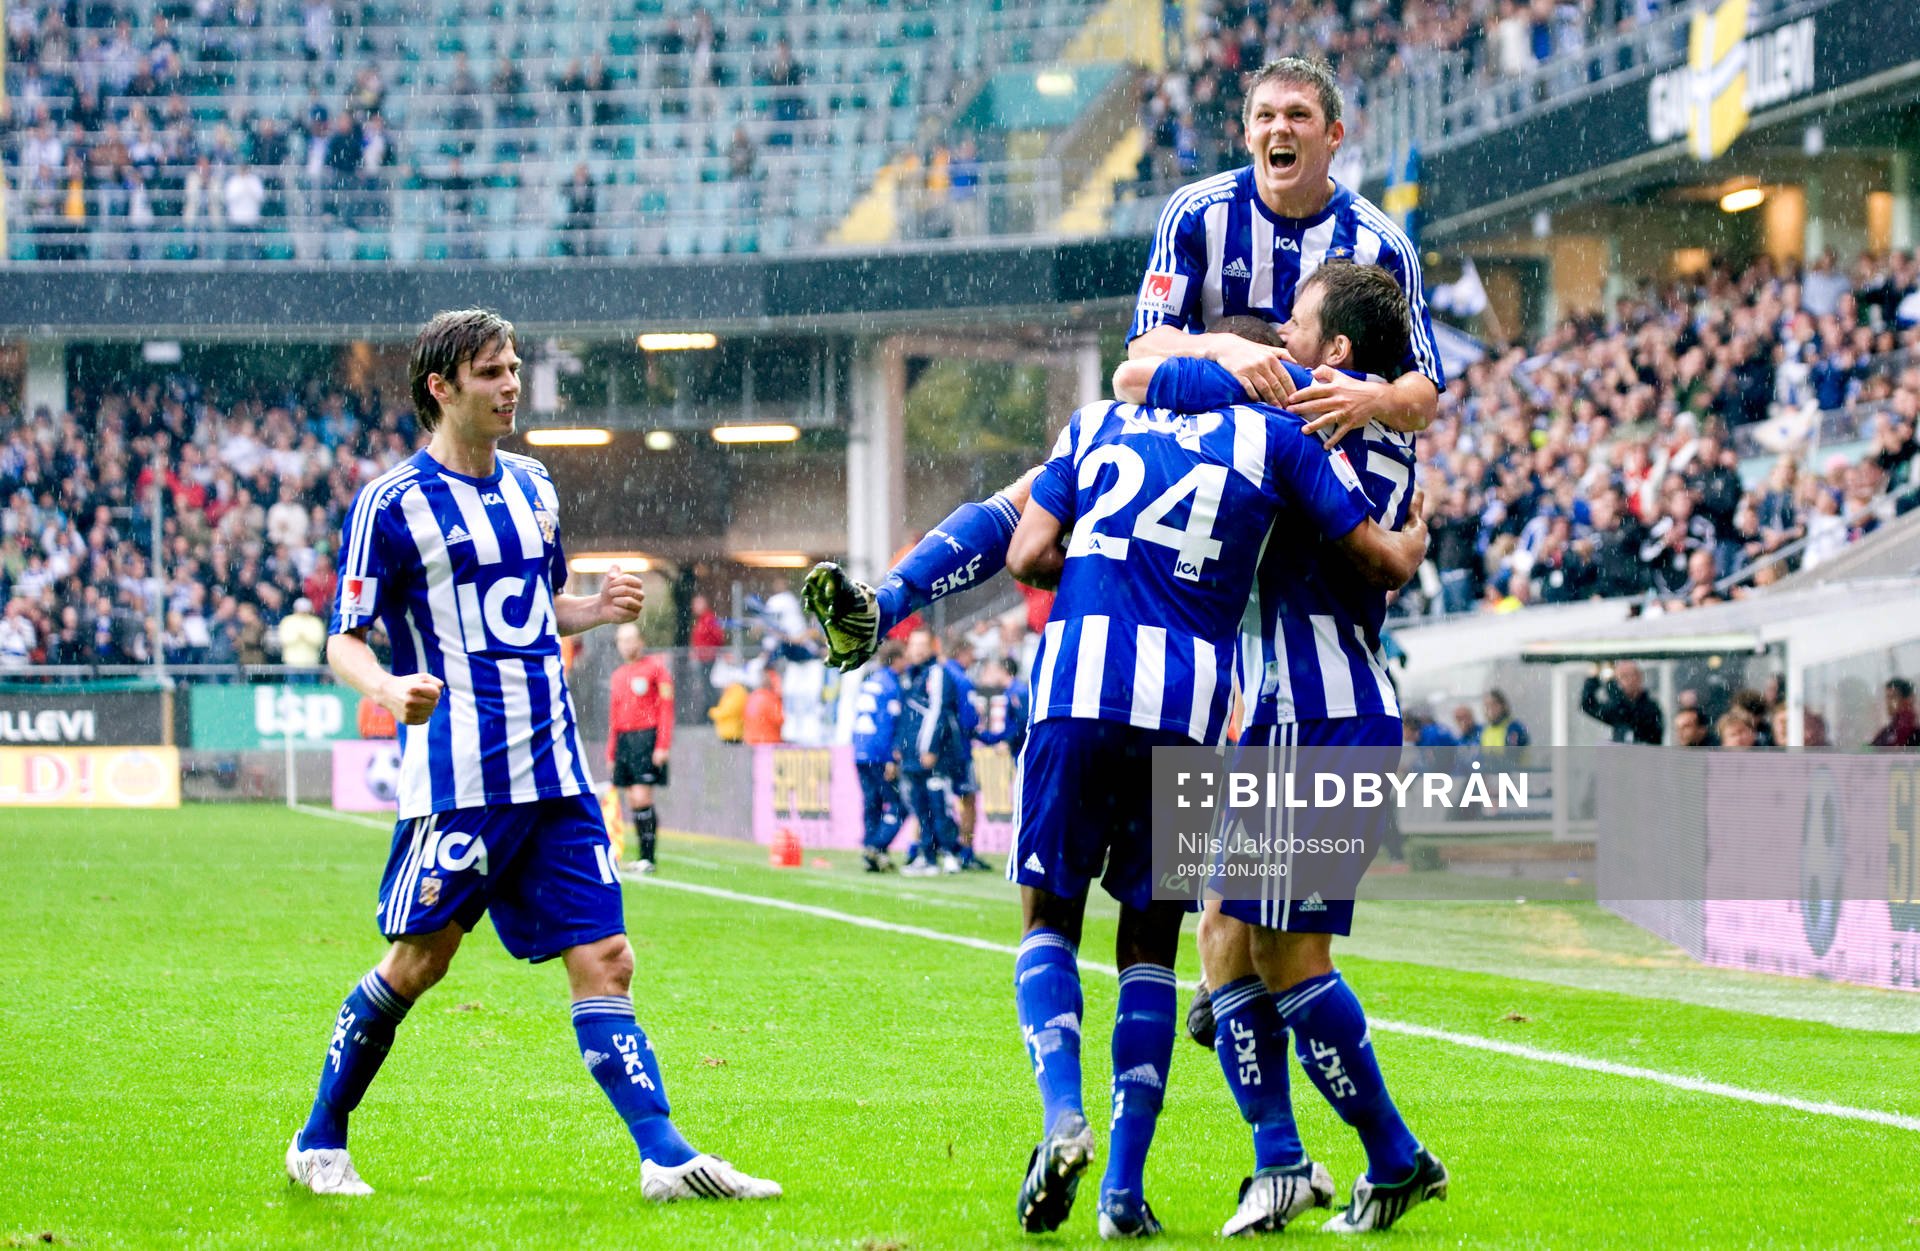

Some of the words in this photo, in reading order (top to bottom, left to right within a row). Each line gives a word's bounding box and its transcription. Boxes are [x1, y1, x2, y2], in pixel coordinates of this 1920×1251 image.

[1275, 236, 1300, 252] ICA
[1222, 268, 1251, 279] adidas
[481, 492, 505, 506] ICA
[1066, 444, 1229, 582] 24
[930, 553, 983, 600] SKF
[1176, 561, 1200, 577] ICA
[457, 574, 557, 653] ICA
[0, 709, 95, 741] LLEVI
[422, 830, 489, 876] ICA
[1158, 872, 1191, 894] ICA
[329, 1003, 356, 1073] SKF
[1230, 1019, 1261, 1086] SKF
[612, 1033, 655, 1091] SKF
[1310, 1038, 1357, 1098] SKF
